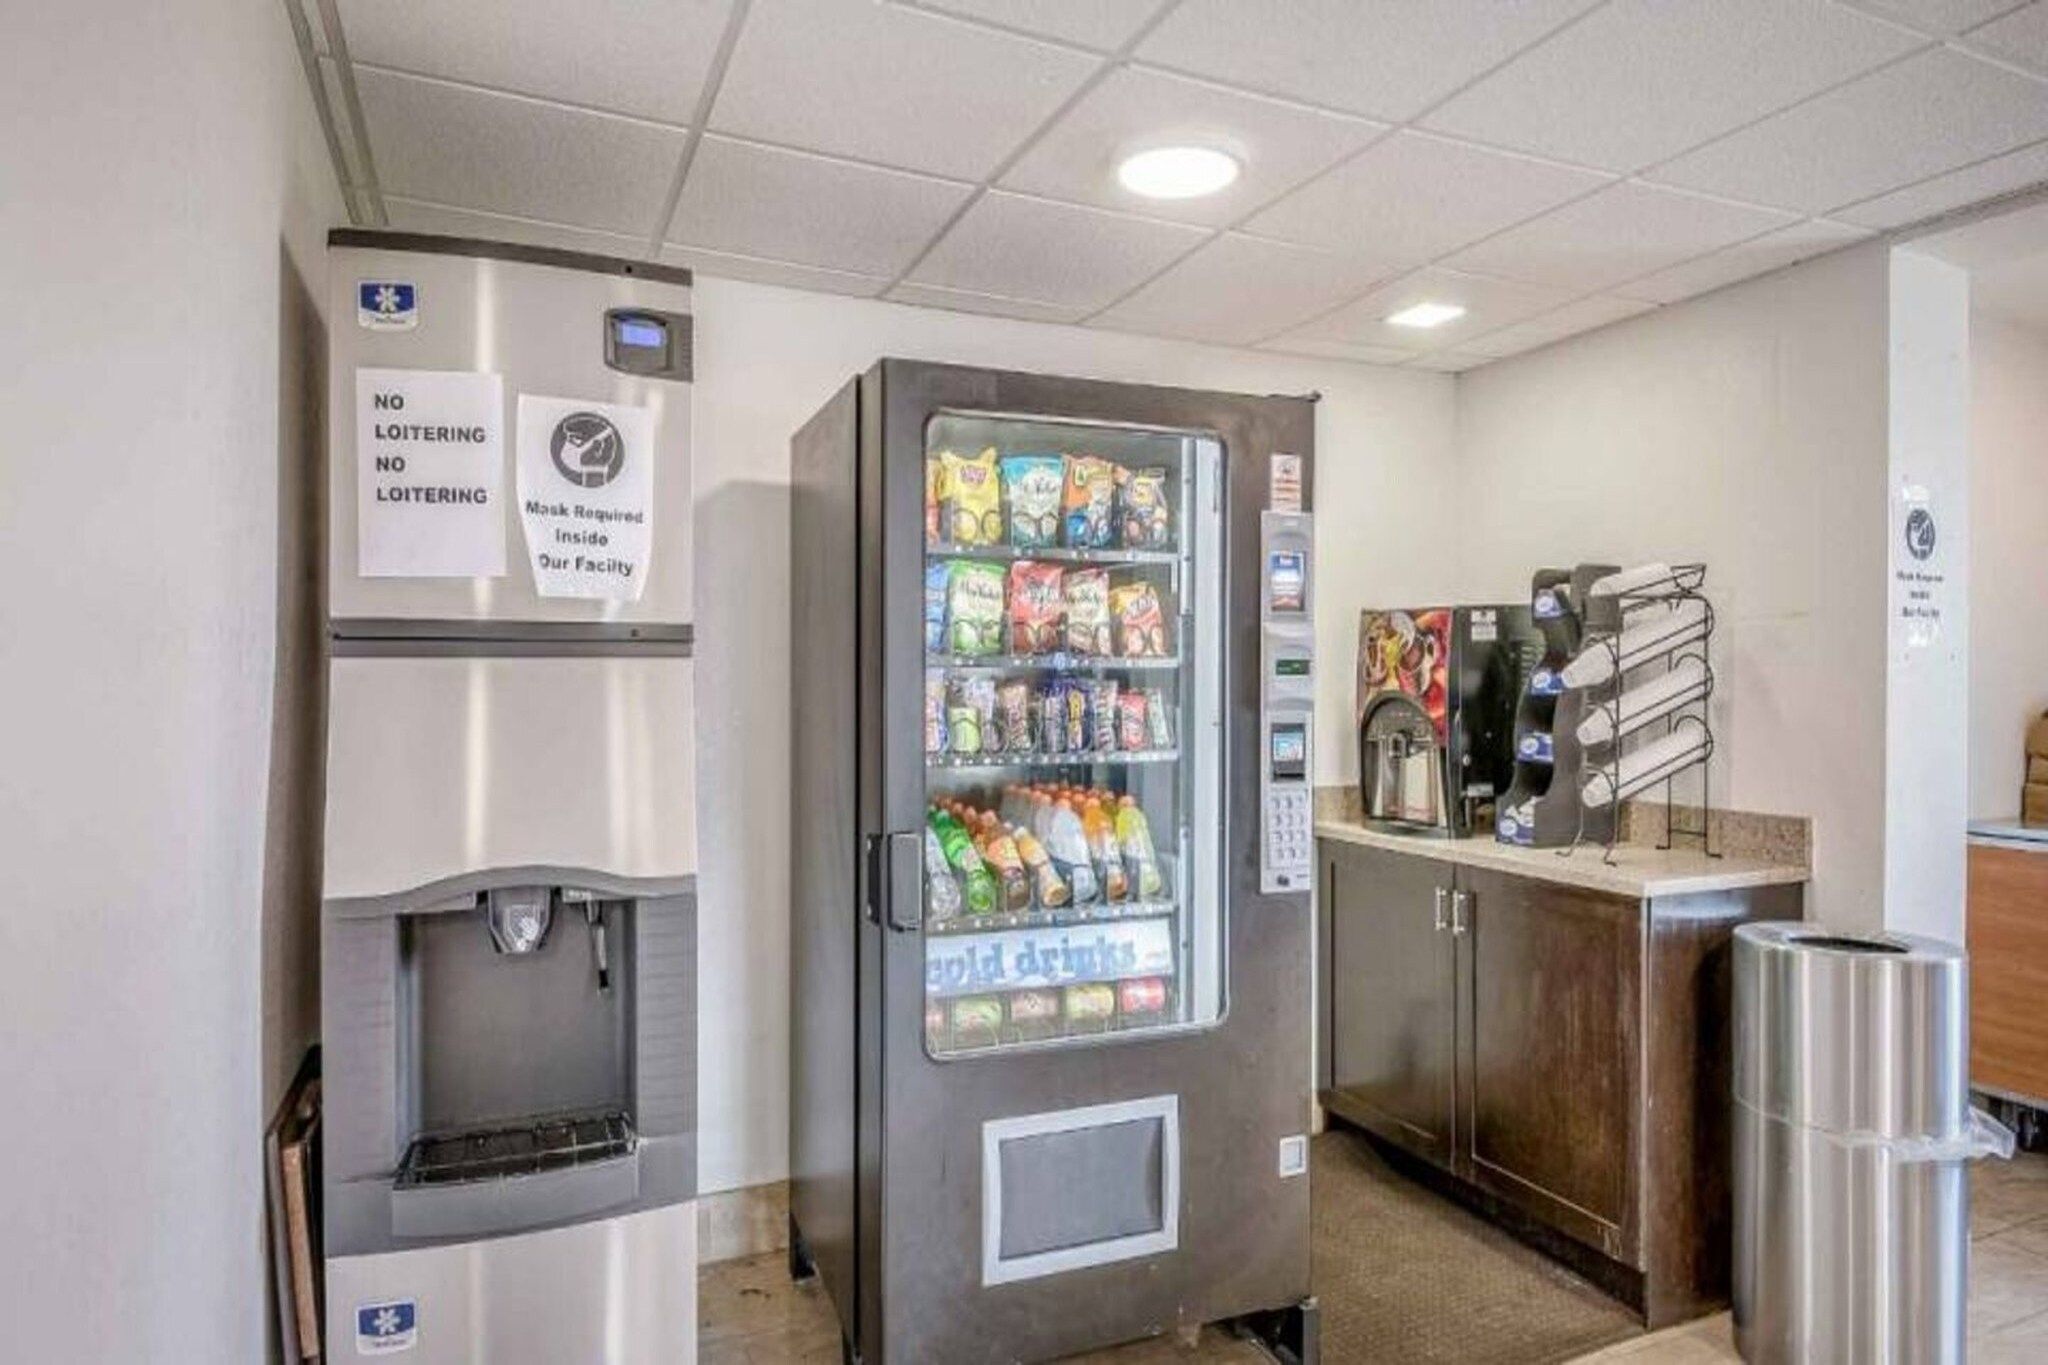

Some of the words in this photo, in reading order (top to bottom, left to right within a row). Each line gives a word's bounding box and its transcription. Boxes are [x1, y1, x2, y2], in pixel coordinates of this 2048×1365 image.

[375, 394, 404, 410] NO
[375, 424, 486, 443] LOITERING
[376, 456, 406, 472] NO
[377, 487, 488, 504] LOITERING
[526, 500, 569, 517] Mask
[574, 504, 643, 524] Required
[555, 528, 608, 546] Inside
[575, 556, 634, 577] Facilty
